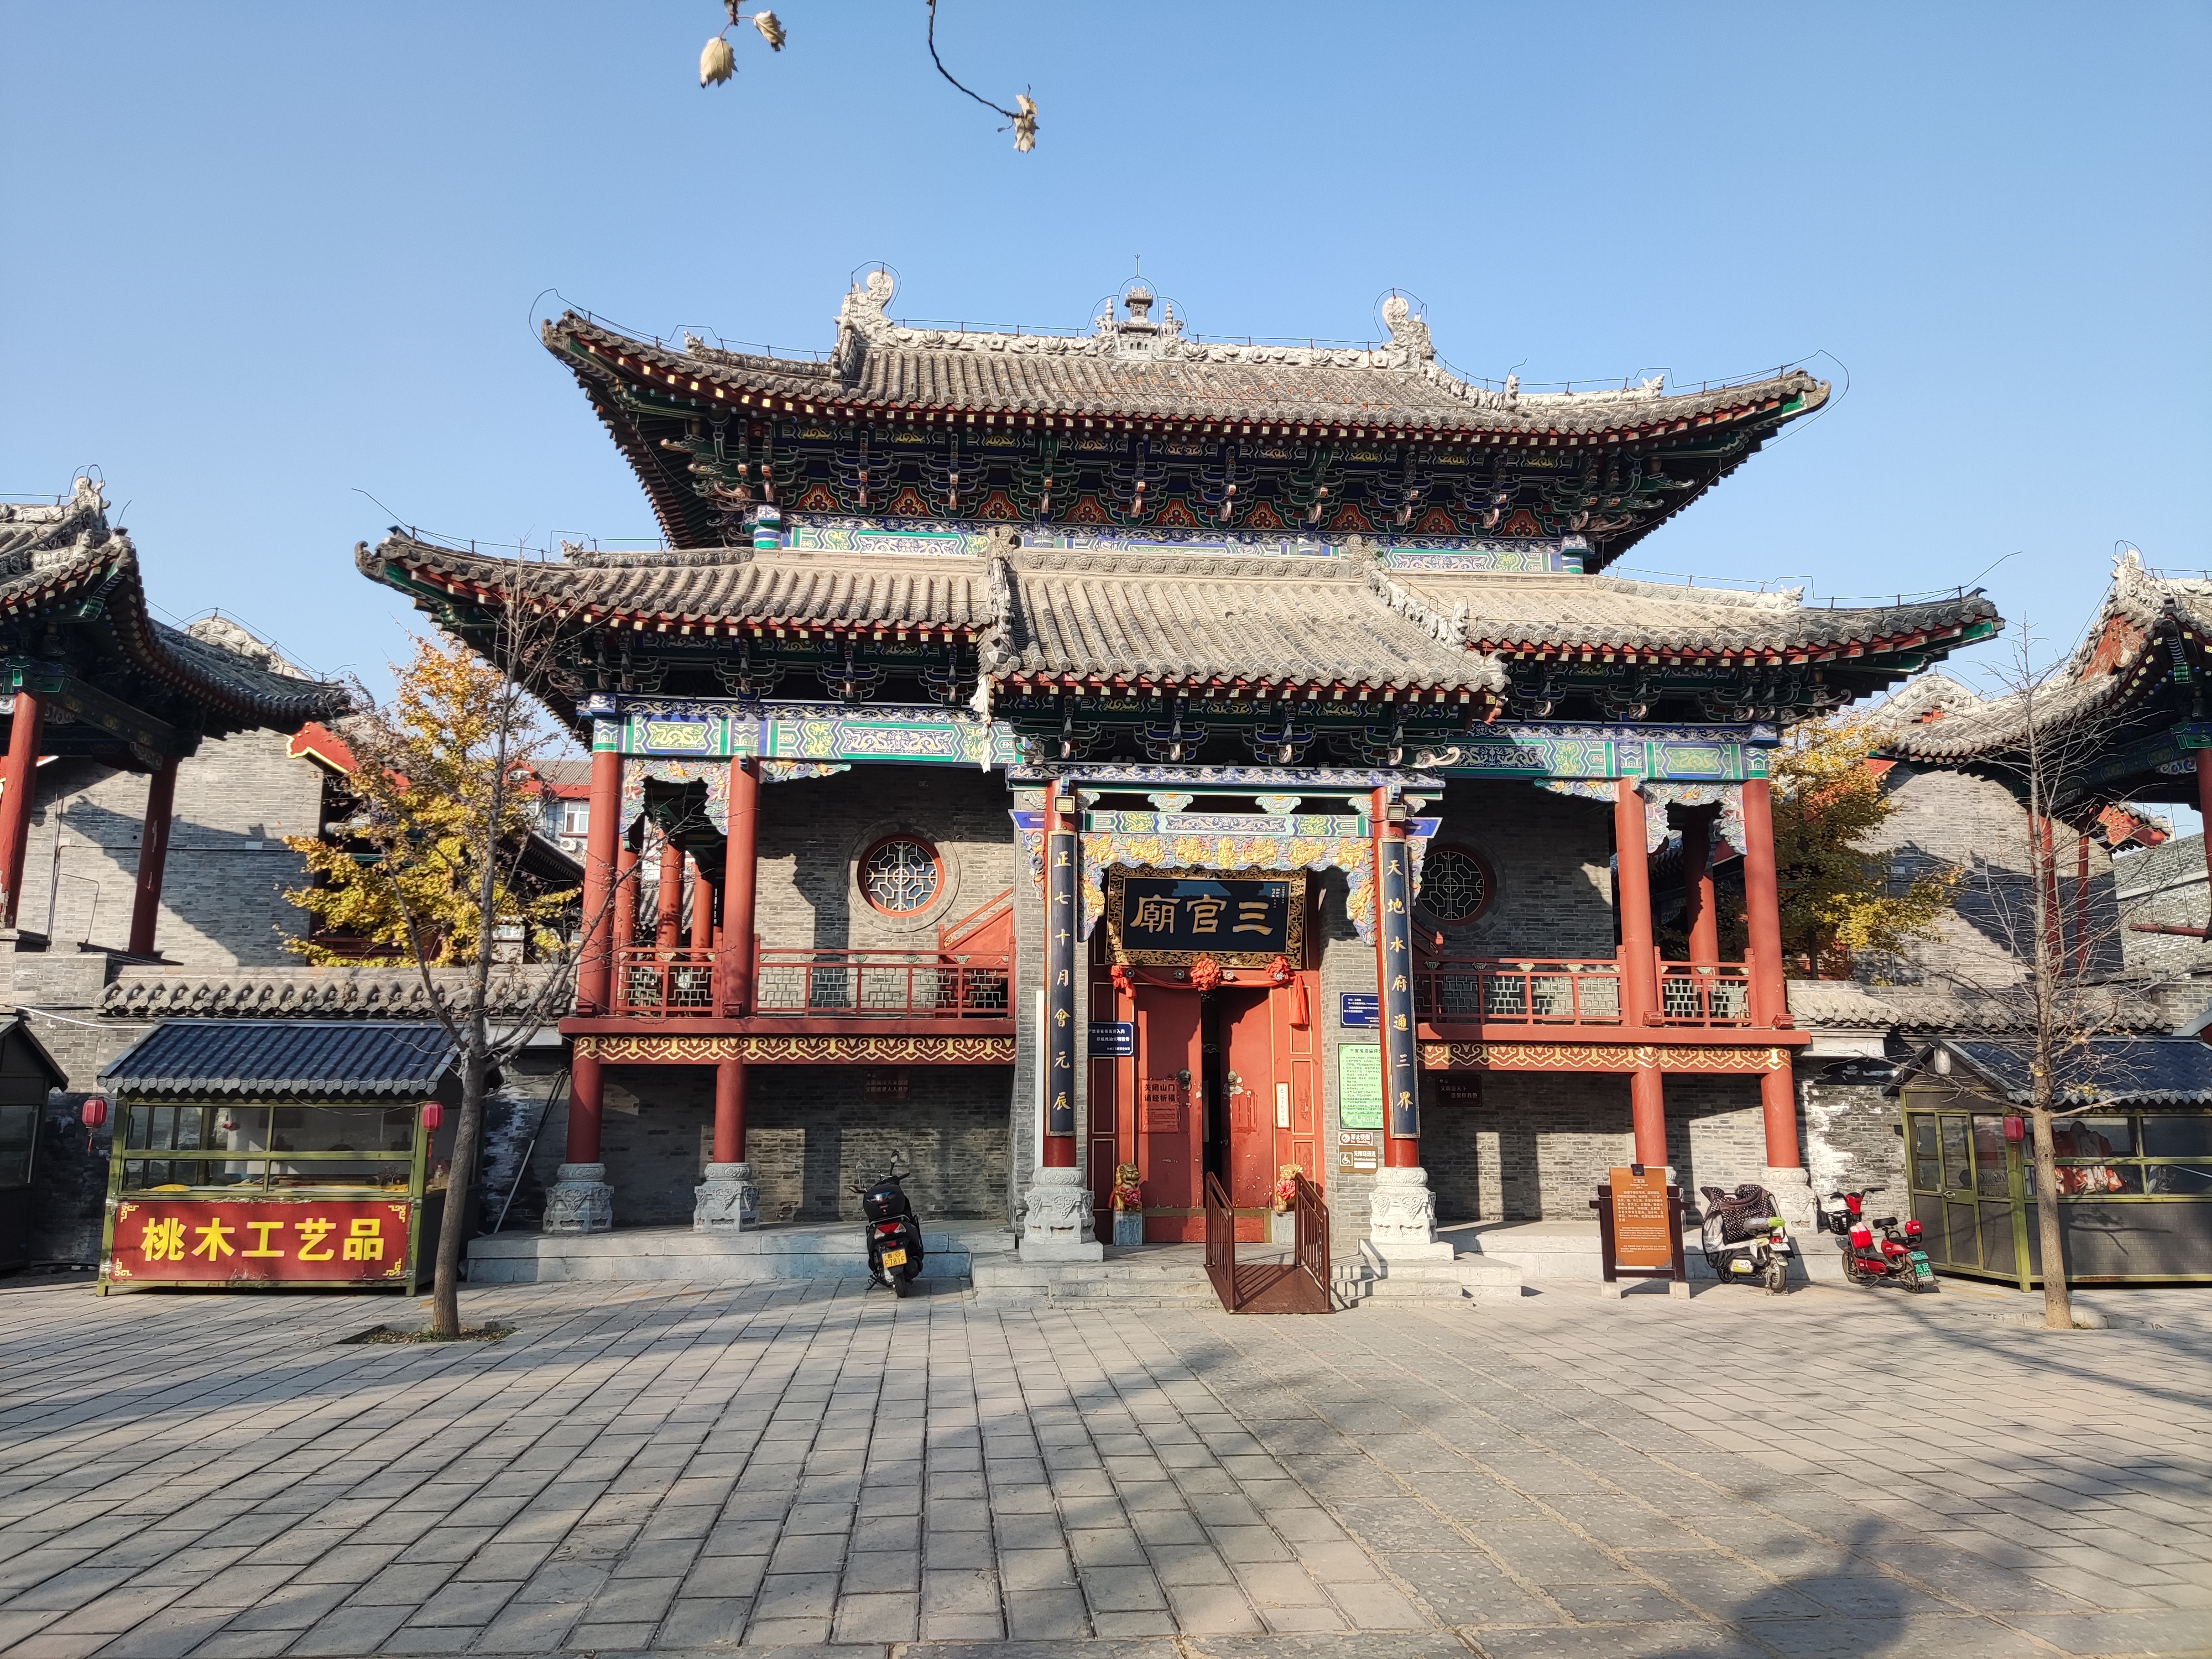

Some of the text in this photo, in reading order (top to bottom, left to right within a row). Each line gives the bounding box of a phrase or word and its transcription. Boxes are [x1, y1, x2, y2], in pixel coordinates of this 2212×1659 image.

[1053, 851, 1072, 1111] 正七十月會元辰
[1130, 894, 1274, 936] 三官廟
[1386, 859, 1414, 1112] 天地水府通三界
[140, 1217, 385, 1261] 桃木工艺品
